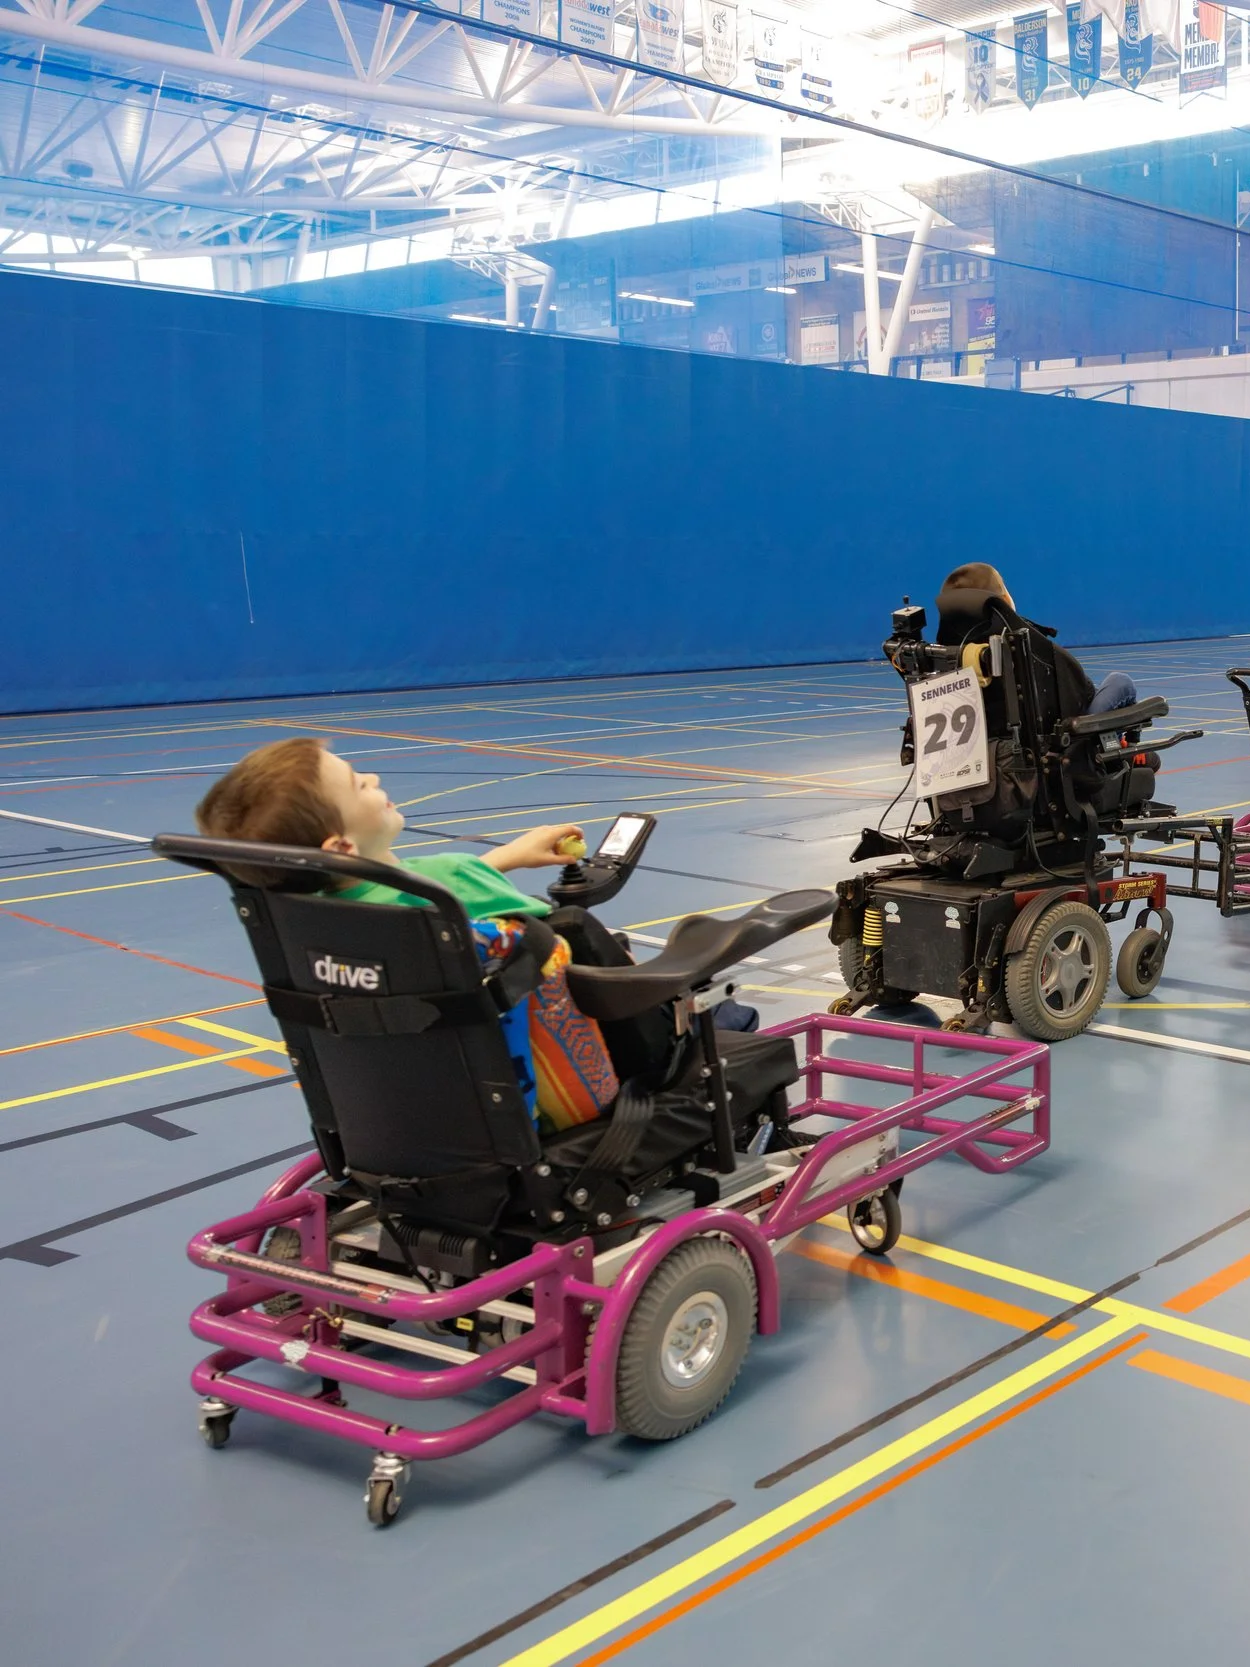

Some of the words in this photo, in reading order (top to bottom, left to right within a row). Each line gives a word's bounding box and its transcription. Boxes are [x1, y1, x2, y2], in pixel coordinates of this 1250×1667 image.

[494, 1, 531, 16] CHAMPIONS
[569, 25, 606, 41] CHAMPIONS
[580, 35, 596, 46] 2007
[973, 44, 990, 64] 10
[1184, 41, 1219, 70] MEMBRE
[1127, 67, 1142, 81] 24
[1078, 77, 1090, 92] 10
[1025, 89, 1036, 102] 31
[768, 270, 791, 283] Global
[795, 267, 817, 279] NEWS
[920, 677, 971, 701] SENNEKER
[924, 704, 976, 755] 29
[1118, 882, 1137, 890] STORM
[1137, 880, 1155, 888] SERIES
[314, 954, 379, 990] drive
